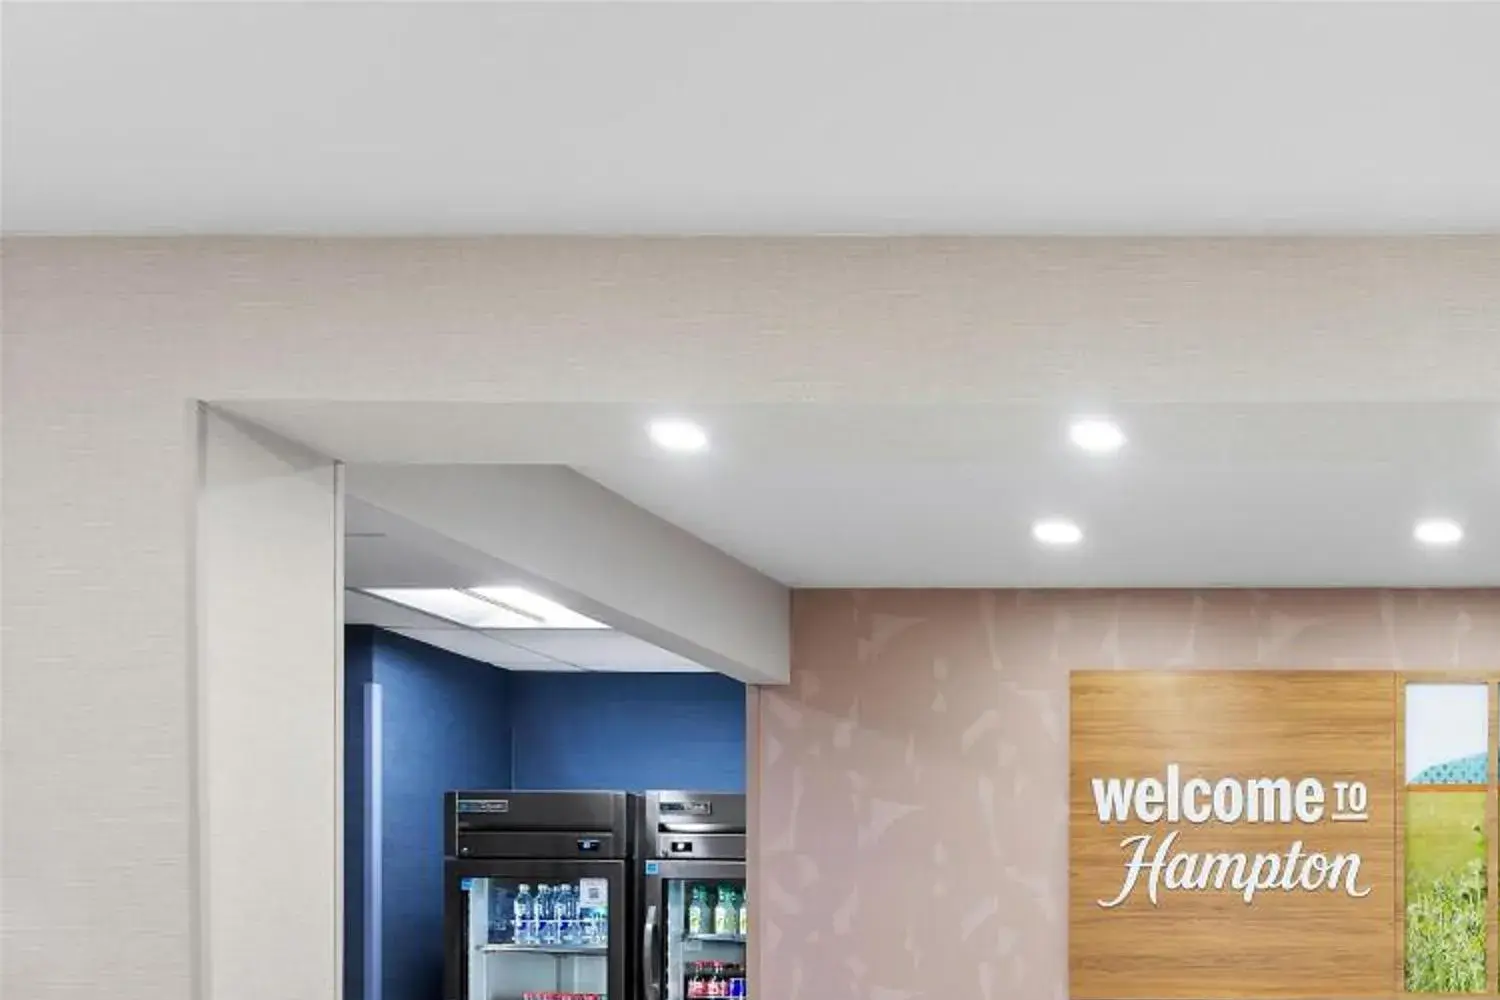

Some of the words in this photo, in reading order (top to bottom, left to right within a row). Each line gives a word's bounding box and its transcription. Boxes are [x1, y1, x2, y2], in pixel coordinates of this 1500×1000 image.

[1091, 763, 1326, 823] welcome
[1331, 780, 1369, 815] TO
[1097, 830, 1372, 907] Hampton
